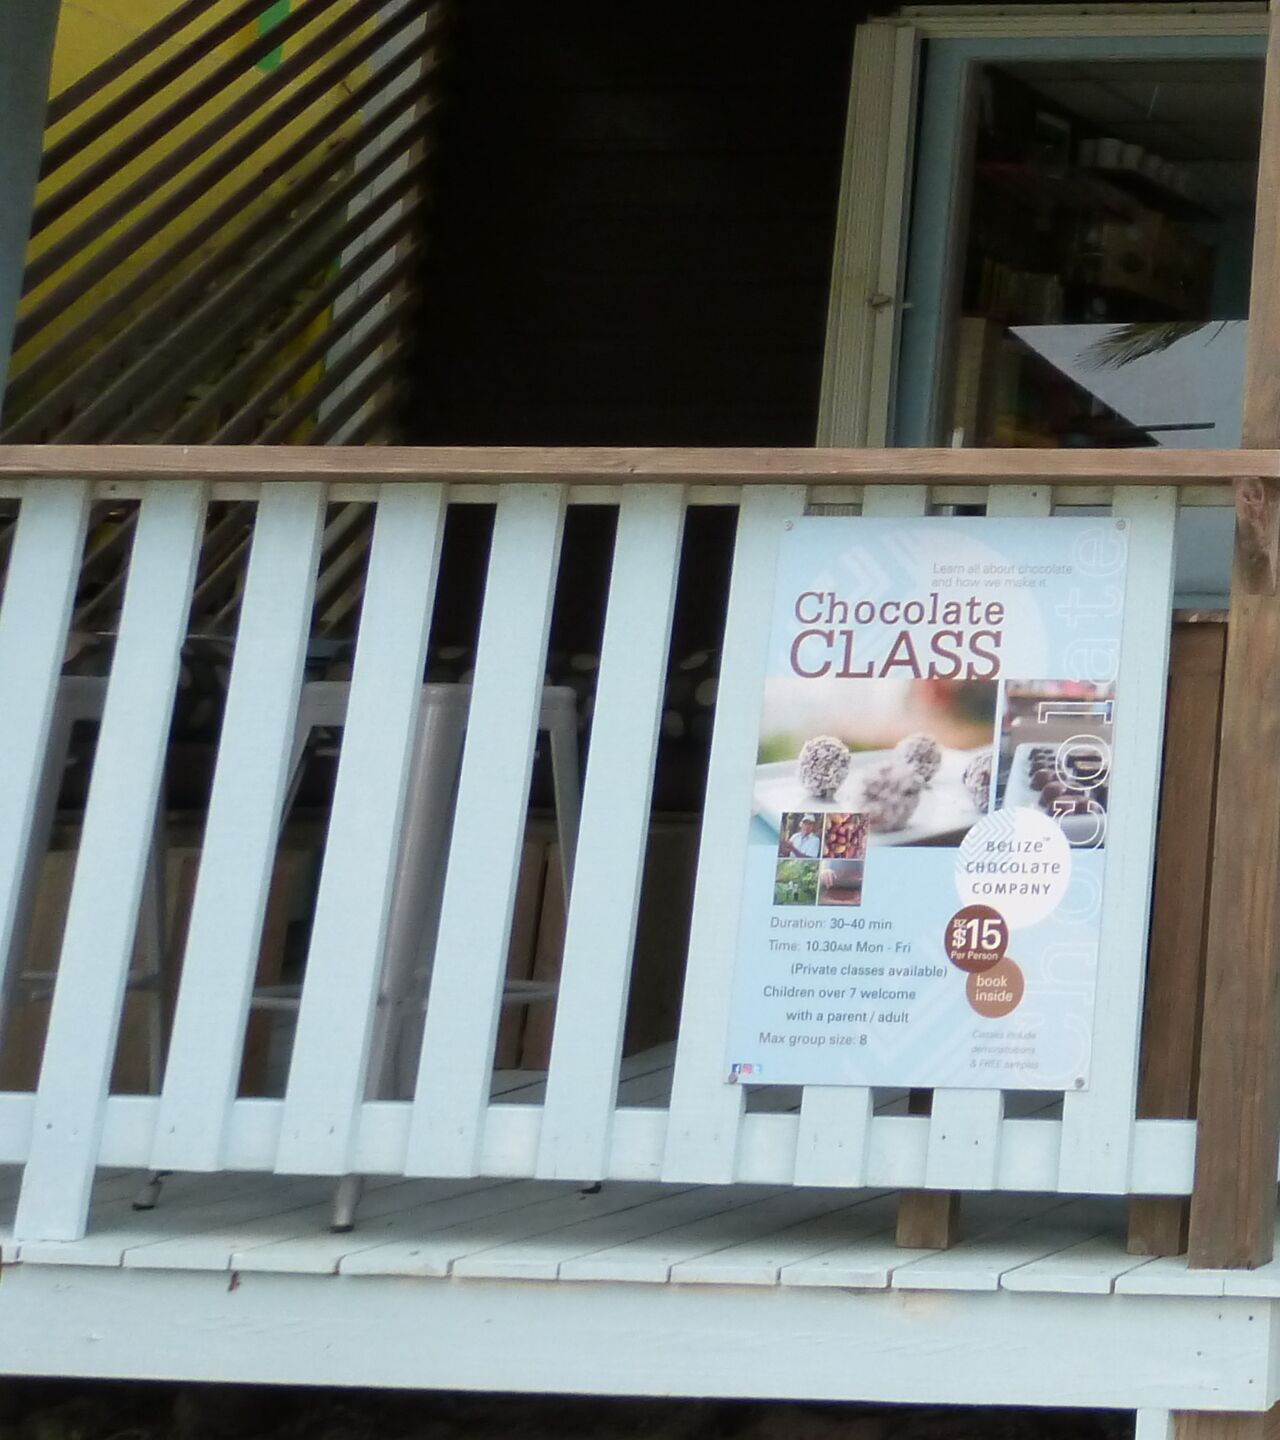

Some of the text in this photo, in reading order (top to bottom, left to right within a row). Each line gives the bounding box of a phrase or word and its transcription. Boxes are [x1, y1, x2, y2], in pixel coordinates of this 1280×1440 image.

[932, 562, 1073, 575] Learn all about chocolate
[931, 576, 953, 587] and
[956, 577, 981, 587] how
[983, 578, 1001, 587] we
[1004, 577, 1036, 587] make
[794, 591, 1005, 626] Chocolate
[790, 628, 1003, 680] CLASS
[770, 916, 826, 929] Duration:
[869, 919, 893, 930] min
[952, 918, 1002, 950] $15
[768, 939, 801, 952] Time:
[856, 941, 884, 953] Mon
[895, 942, 911, 953] Fri
[950, 950, 999, 960] Per Person
[791, 963, 948, 978] (Private classes available)
[976, 974, 1008, 988] book
[763, 985, 916, 1000] Children over 7 welcome
[975, 988, 1013, 1002] inside
[786, 1010, 812, 1022] with
[827, 1012, 867, 1024] parent
[878, 1011, 909, 1023] adult
[759, 1032, 785, 1044] Max
[789, 1035, 826, 1047] group
[859, 1034, 868, 1046] 8
